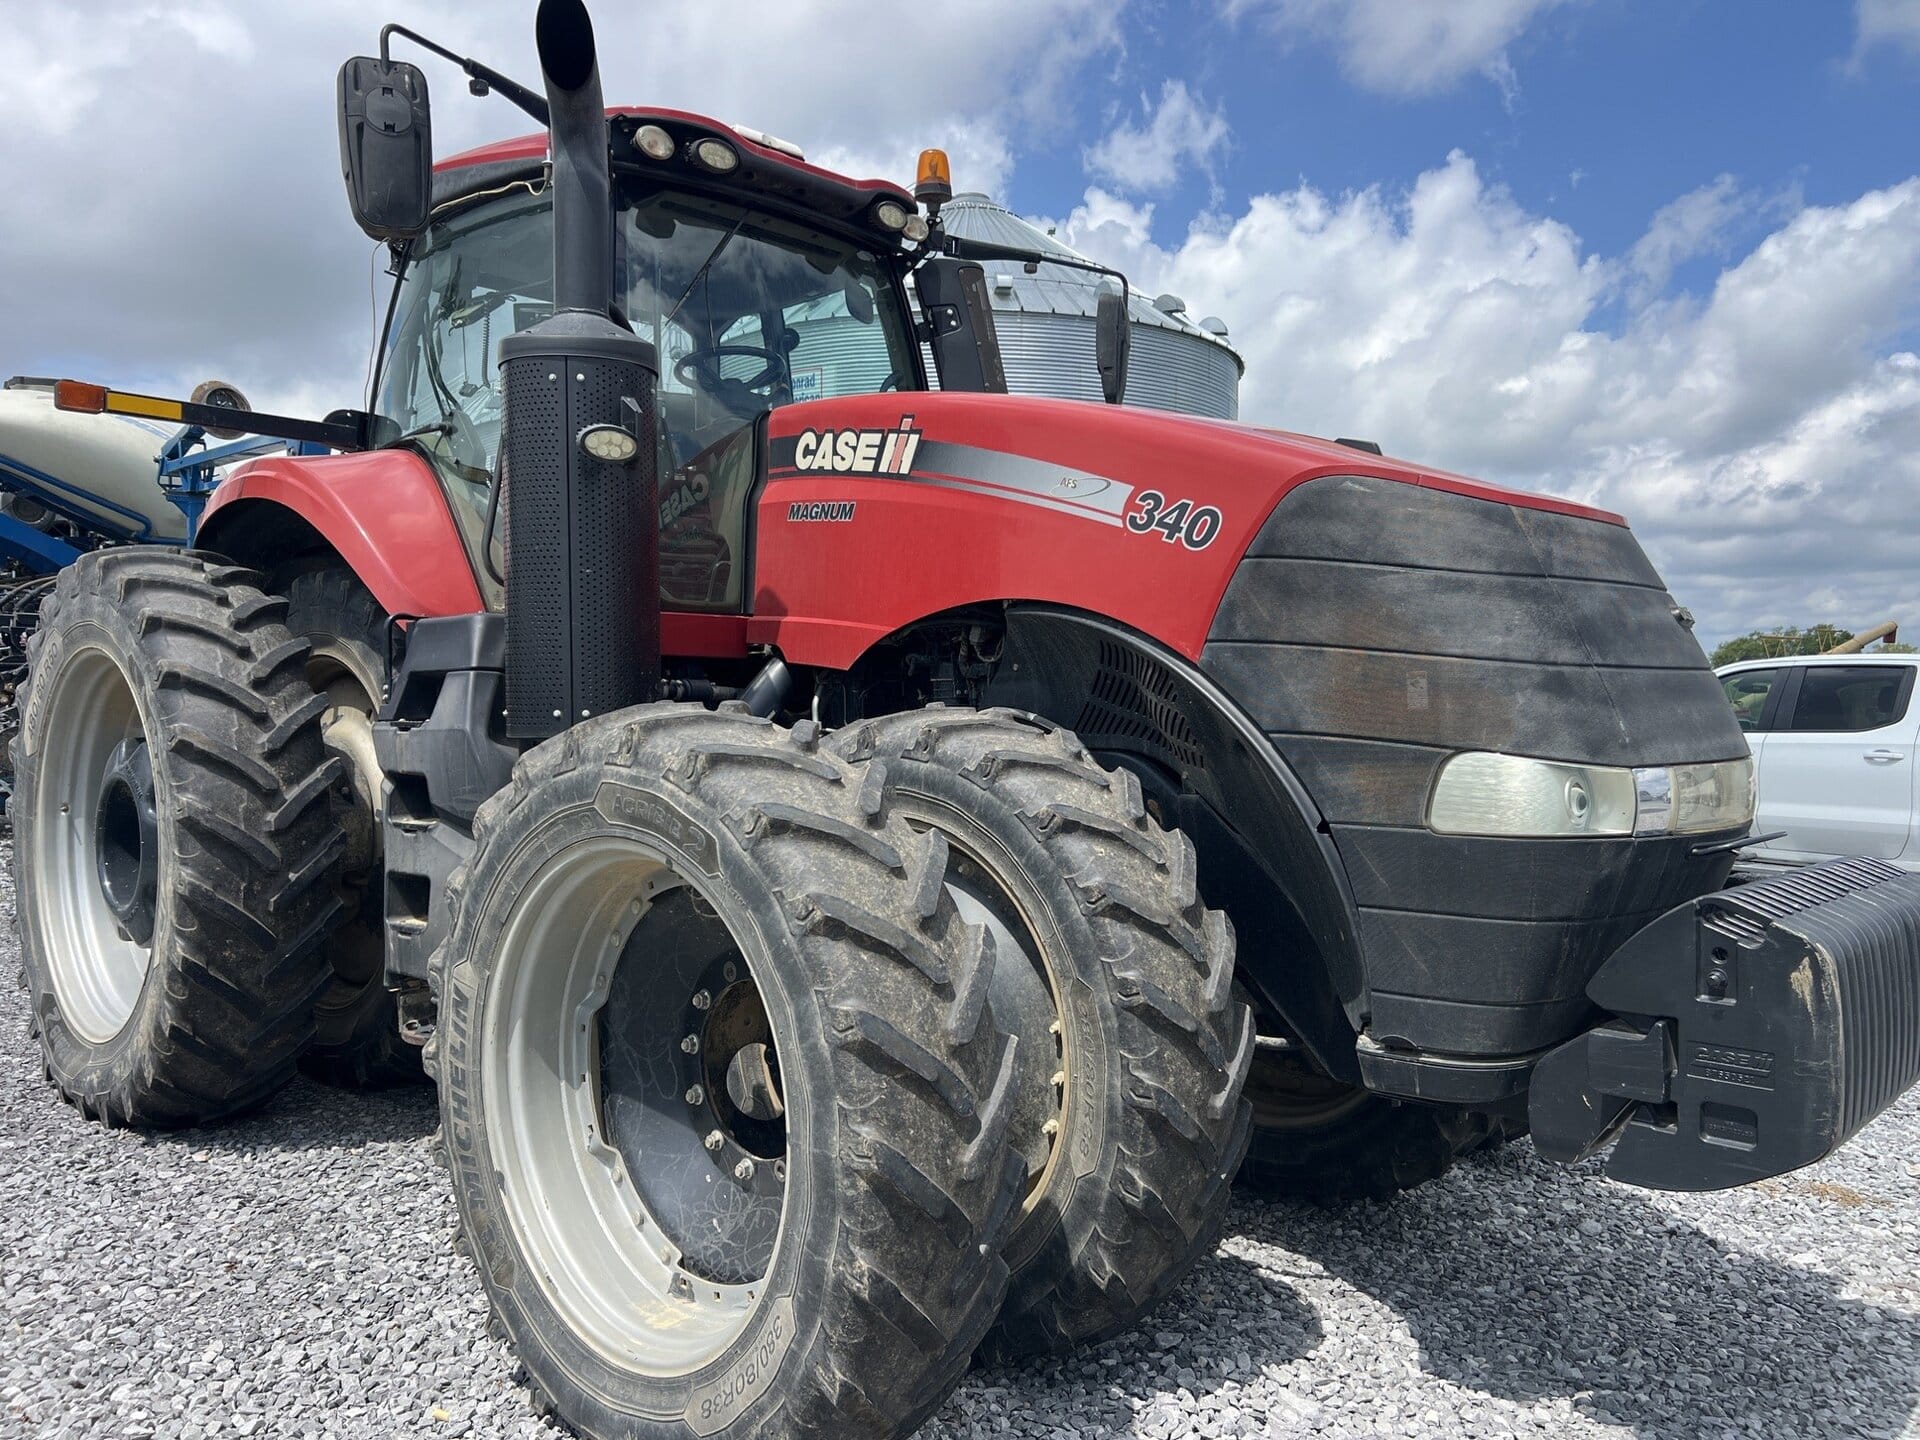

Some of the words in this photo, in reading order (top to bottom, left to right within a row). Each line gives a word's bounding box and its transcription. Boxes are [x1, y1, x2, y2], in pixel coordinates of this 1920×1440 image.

[1060, 477, 1078, 489] AFS
[787, 501, 856, 522] MAGNUM
[1126, 489, 1223, 551] 340
[681, 826, 706, 861] 2
[449, 981, 487, 1211] MICHELIN
[701, 1315, 784, 1420] 380/80R38
